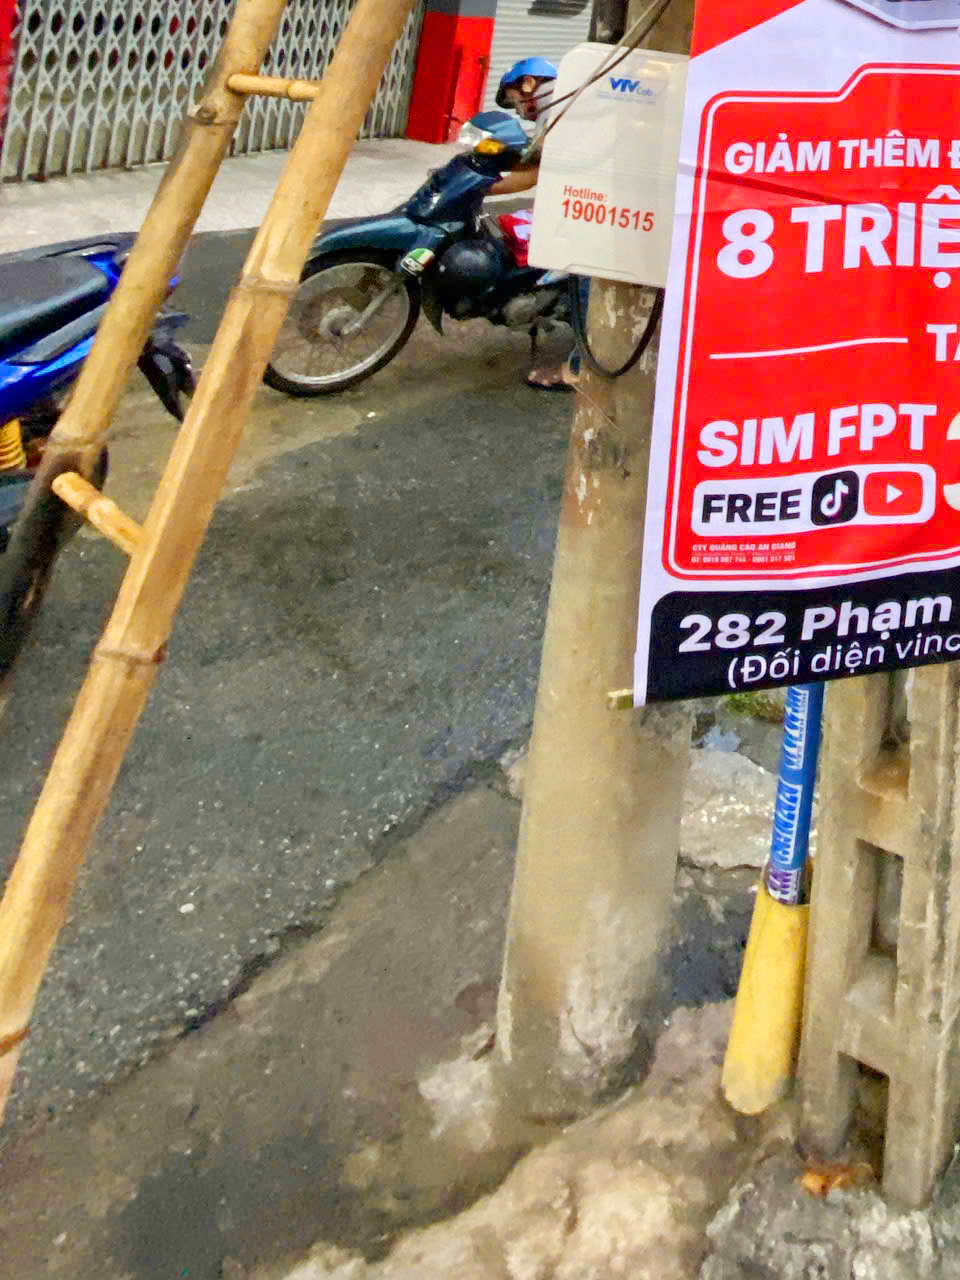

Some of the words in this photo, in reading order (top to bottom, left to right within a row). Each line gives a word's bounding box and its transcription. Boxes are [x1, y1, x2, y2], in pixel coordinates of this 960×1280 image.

[724, 133, 831, 175] GIẢM
[839, 129, 940, 169] THÊM
[561, 198, 655, 233] 19001515
[563, 184, 608, 203] Hotline:
[716, 209, 775, 279] 8
[697, 414, 814, 468] SIM
[826, 403, 938, 457] FPT
[701, 488, 801, 524] FREE
[677, 608, 788, 652] 282
[800, 589, 951, 643] Phạm
[727, 643, 800, 690] (Đối
[810, 632, 885, 677] diện
